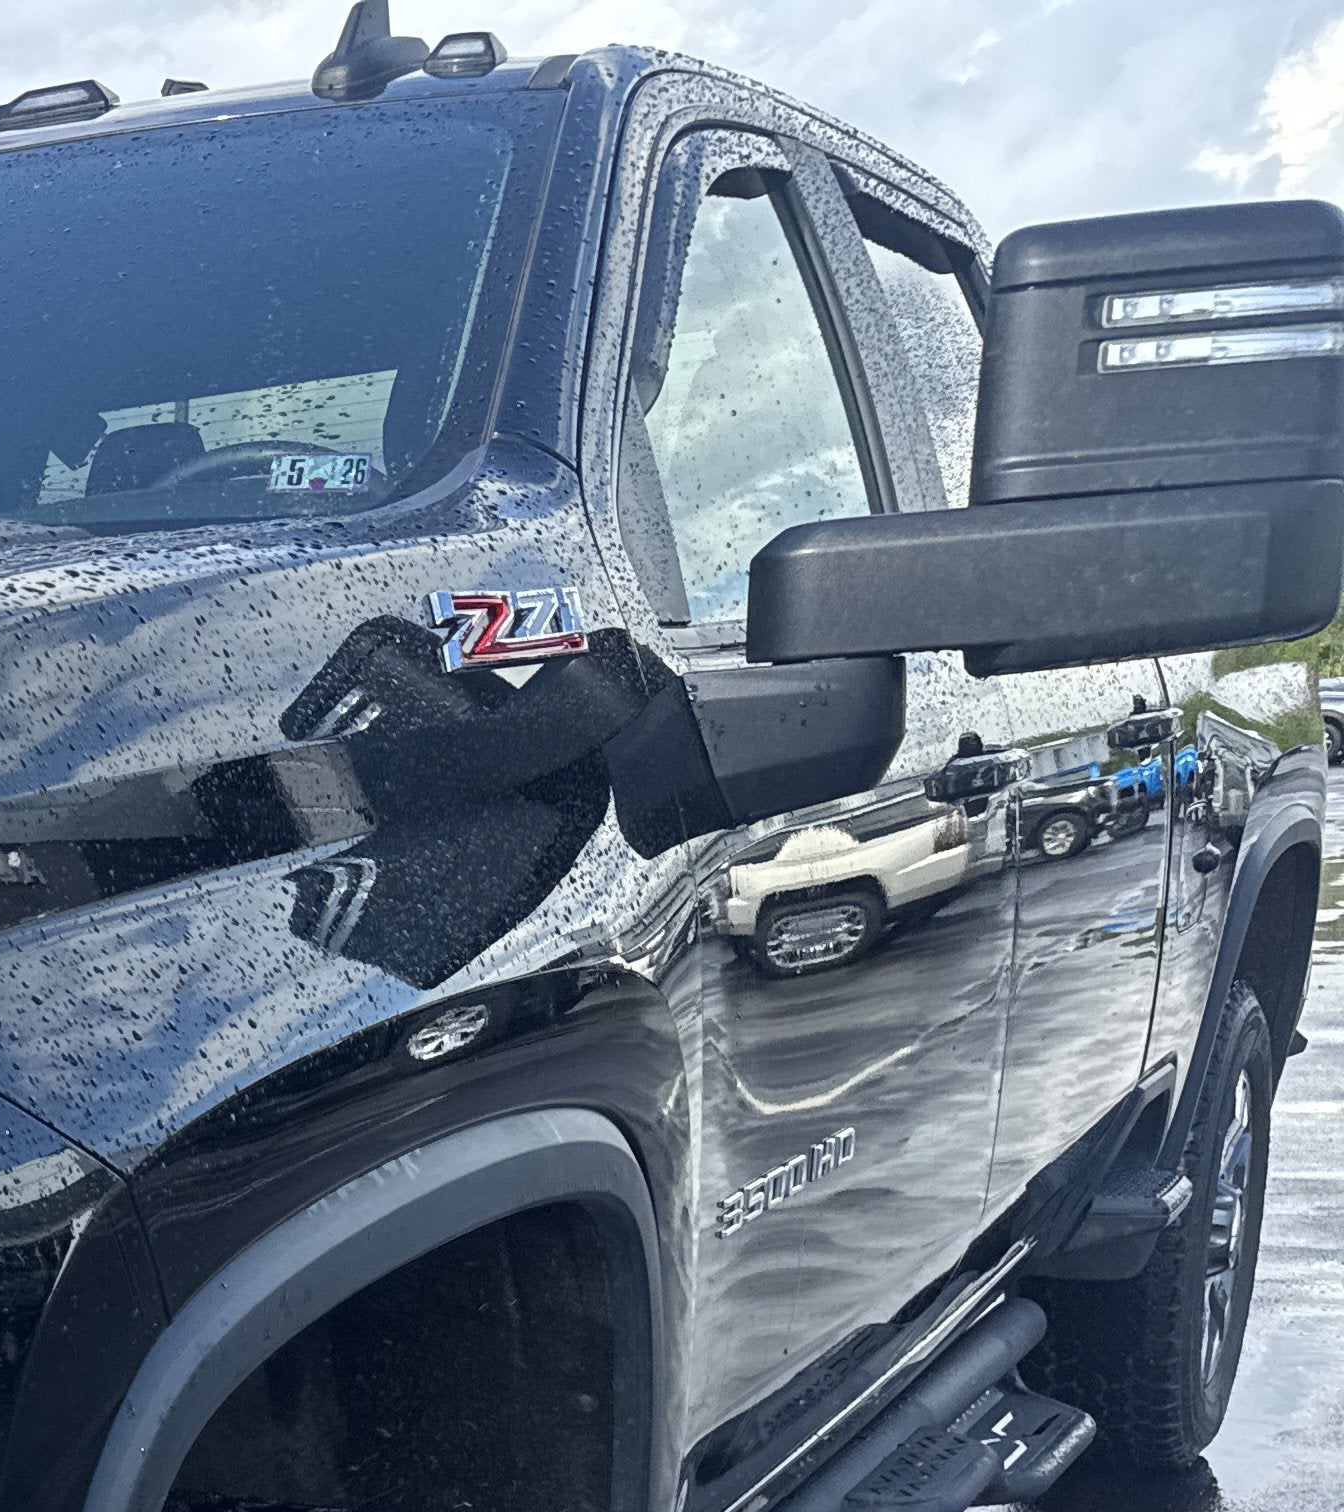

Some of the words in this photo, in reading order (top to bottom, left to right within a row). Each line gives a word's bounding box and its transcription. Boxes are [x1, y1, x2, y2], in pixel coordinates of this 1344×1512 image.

[287, 458, 306, 486] 5
[341, 458, 367, 485] 26
[428, 587, 590, 673] Z71
[808, 1127, 856, 1183] HD
